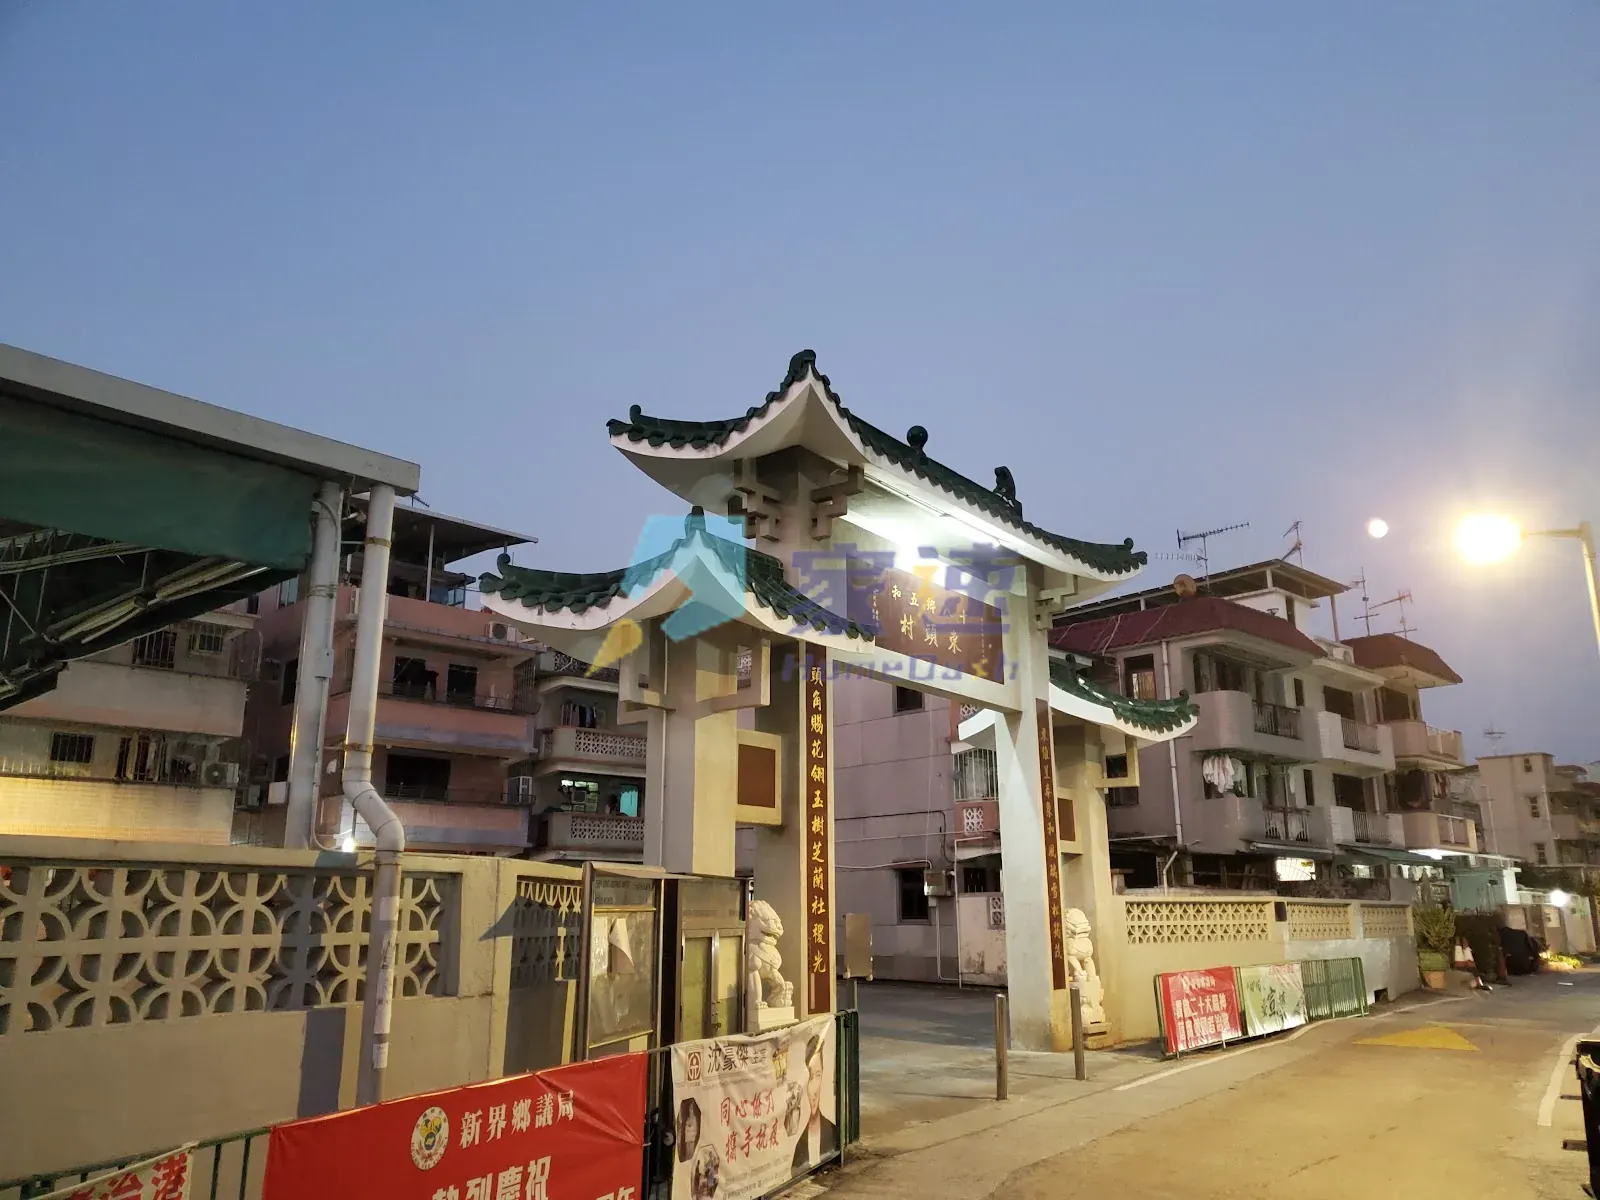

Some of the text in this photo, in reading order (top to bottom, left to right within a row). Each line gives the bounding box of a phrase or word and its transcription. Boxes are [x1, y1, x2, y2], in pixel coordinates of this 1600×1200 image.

[459, 1089, 575, 1149] 新界鄉議局
[66, 1152, 188, 1200] 治港
